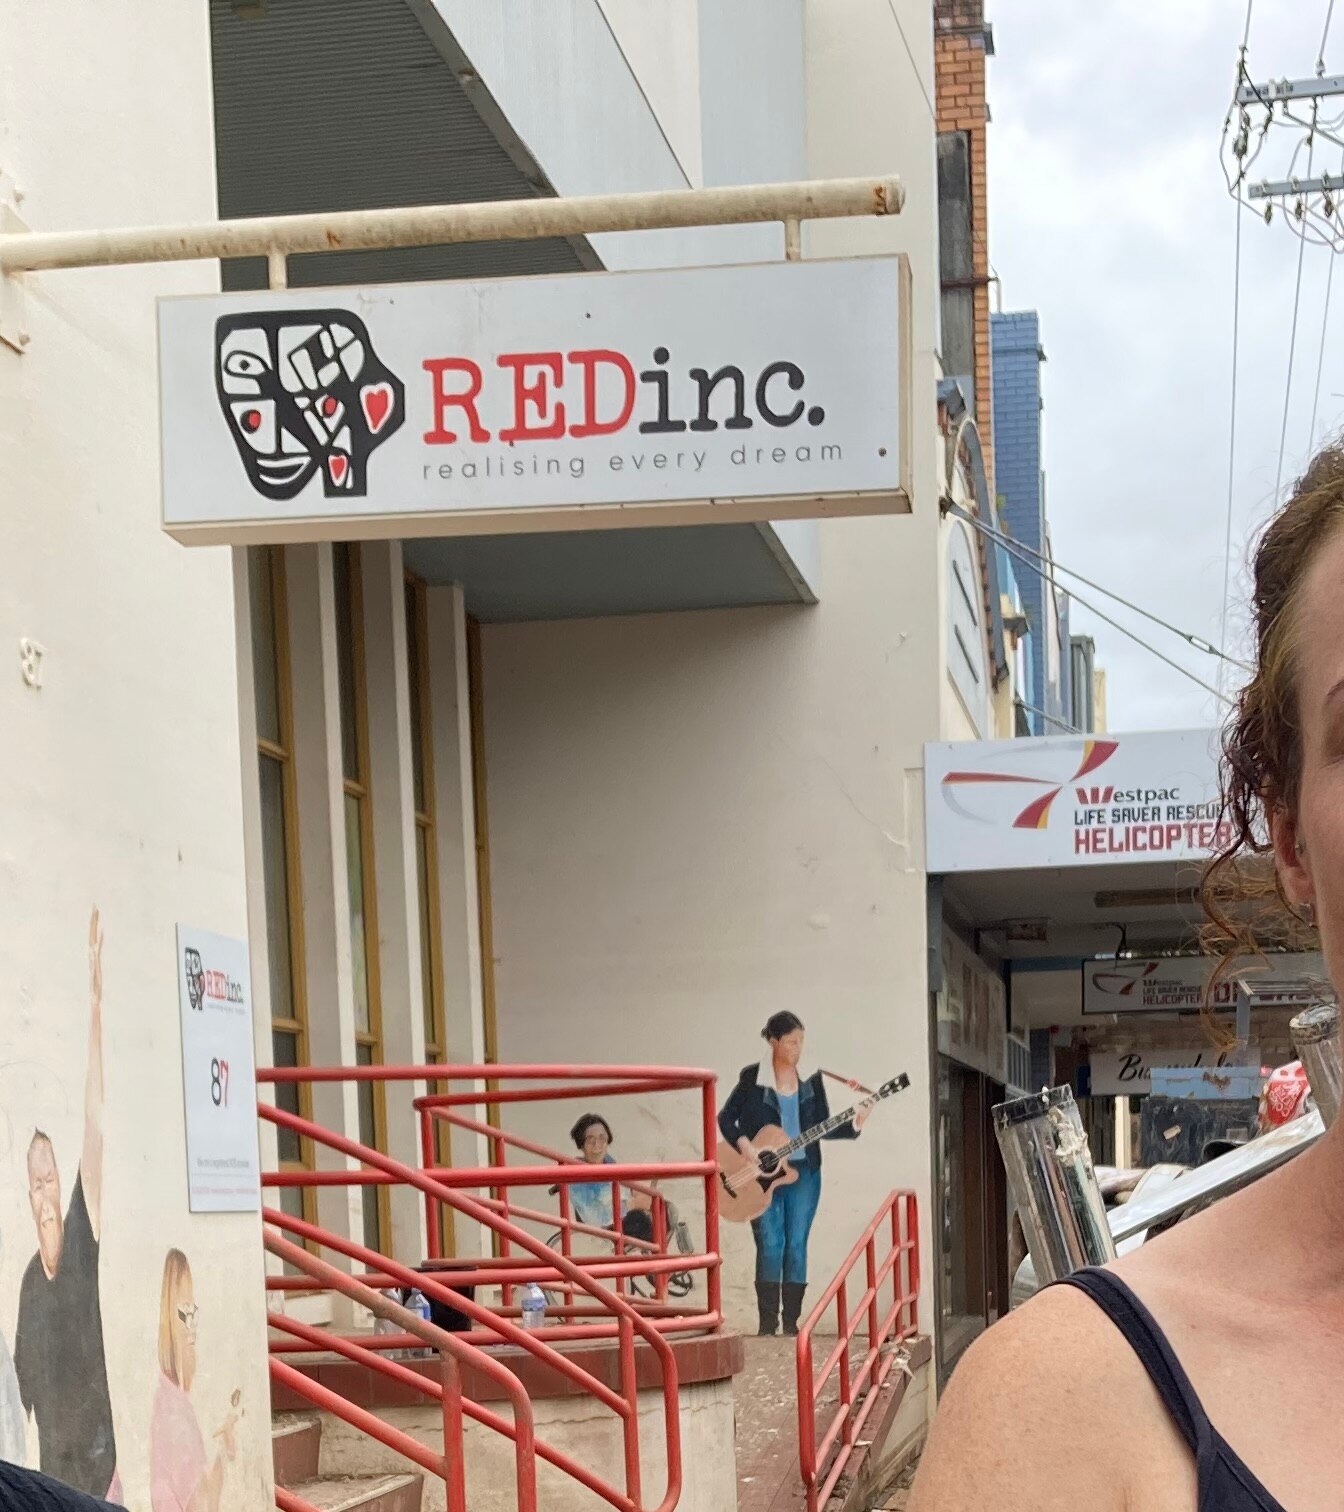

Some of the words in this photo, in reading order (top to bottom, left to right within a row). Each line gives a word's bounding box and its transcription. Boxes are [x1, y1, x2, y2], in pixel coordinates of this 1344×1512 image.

[423, 346, 827, 445] REDinc.
[423, 453, 585, 480] realising
[609, 451, 706, 472] every
[730, 443, 843, 465] dream
[1075, 786, 1180, 804] Westpac
[1074, 809, 1106, 826] LIFE
[1111, 806, 1161, 824] SAVER
[1074, 821, 1234, 854] HELICOPTER
[211, 1057, 230, 1107] 87
